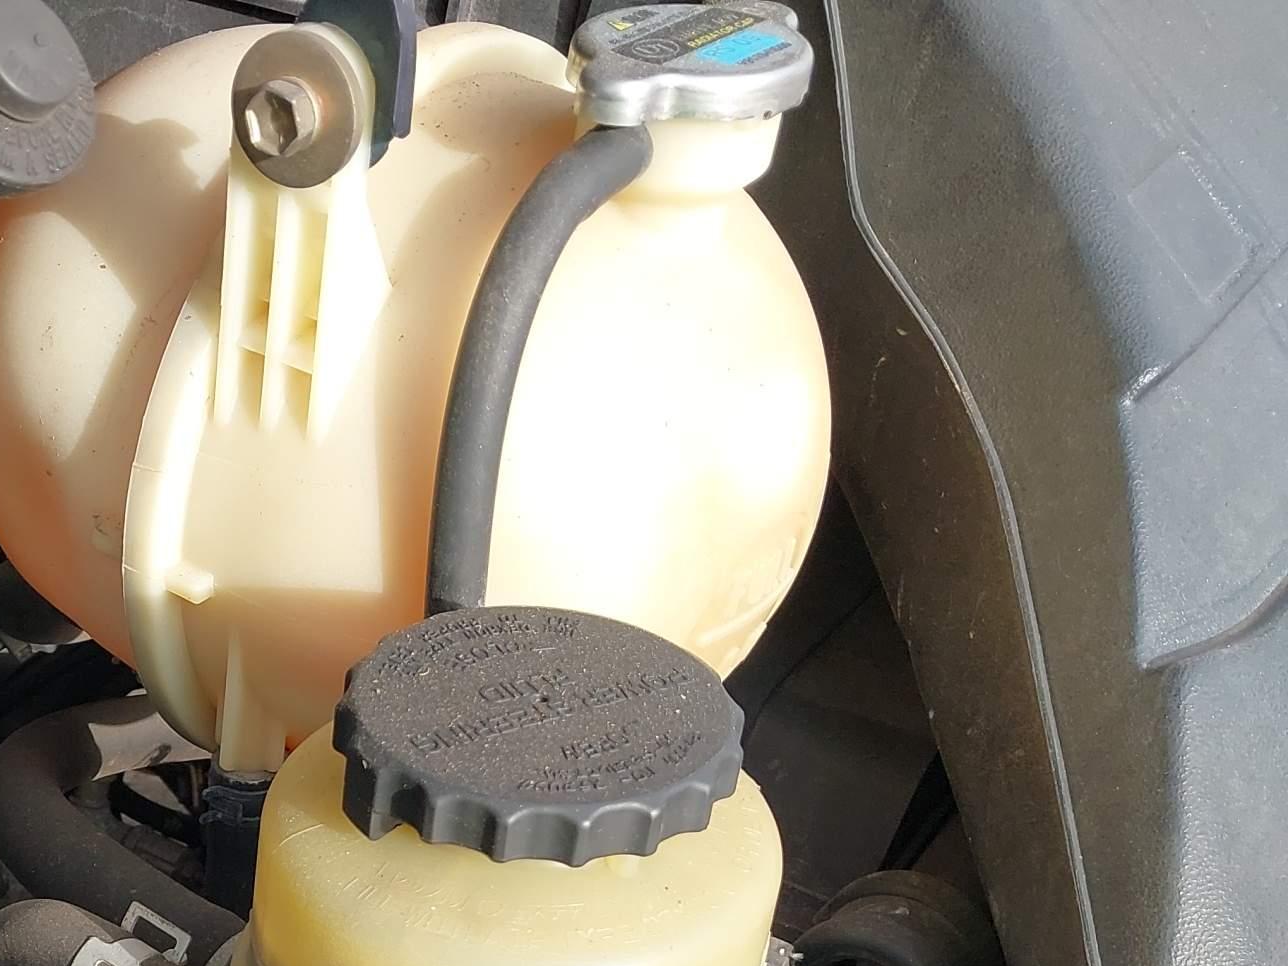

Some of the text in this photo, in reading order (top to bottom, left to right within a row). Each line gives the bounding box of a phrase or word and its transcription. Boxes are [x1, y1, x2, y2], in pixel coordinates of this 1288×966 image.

[412, 667, 698, 754] POWER STEERING
[477, 668, 576, 703] FLUID
